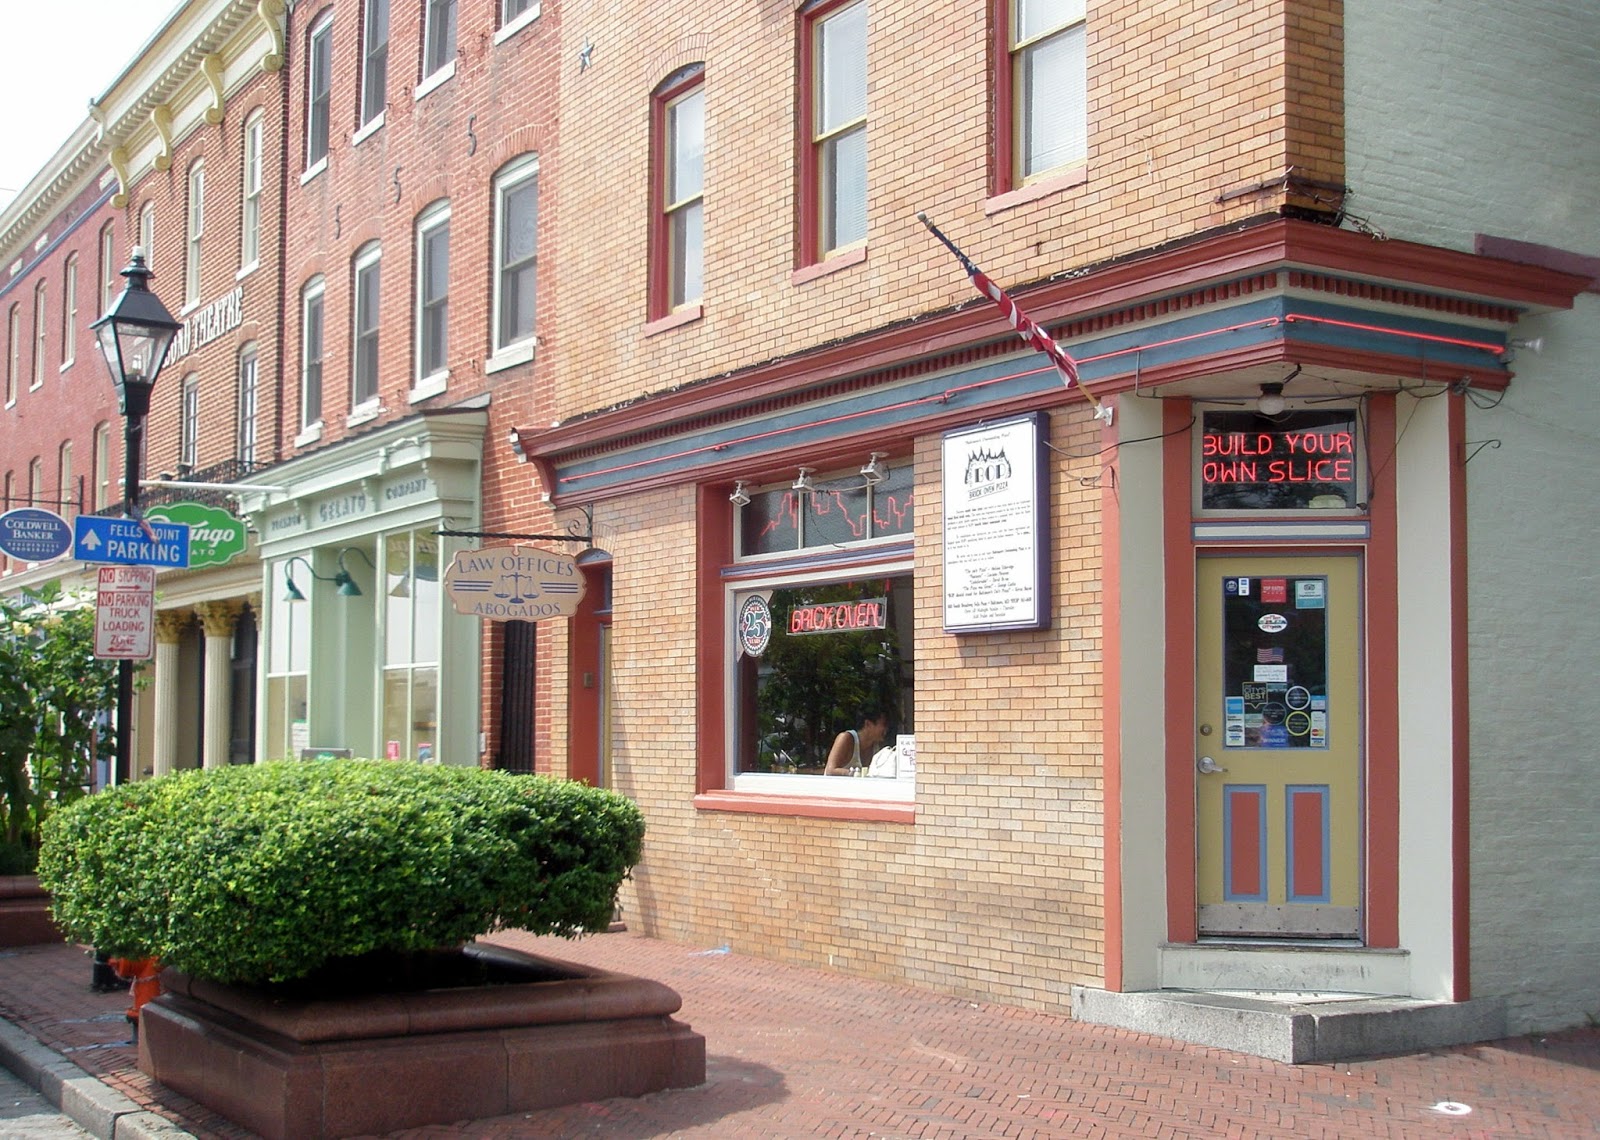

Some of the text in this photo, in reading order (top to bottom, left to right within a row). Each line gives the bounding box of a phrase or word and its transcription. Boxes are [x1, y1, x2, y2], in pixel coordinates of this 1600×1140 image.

[193, 285, 243, 350] THEATRE
[1203, 433, 1352, 456] BUILD YOUR
[974, 462, 1006, 484] BOP
[1203, 460, 1351, 483] OWN SLICE
[5, 519, 61, 531] COLDWELL
[110, 524, 143, 538] FELLS
[13, 529, 54, 540] BANKER
[107, 540, 180, 563] PARKING
[458, 556, 575, 577] LAW OFFICES
[101, 569, 151, 583] NO STOPPING
[100, 592, 150, 607] NO PARKING
[109, 607, 140, 619] TRUCK
[474, 602, 561, 618] ABOGADOS
[791, 605, 835, 633] BRICK
[836, 603, 880, 628] OVEN
[103, 620, 145, 632] LOADING
[745, 611, 766, 638] 25
[110, 634, 137, 646] ZONE
